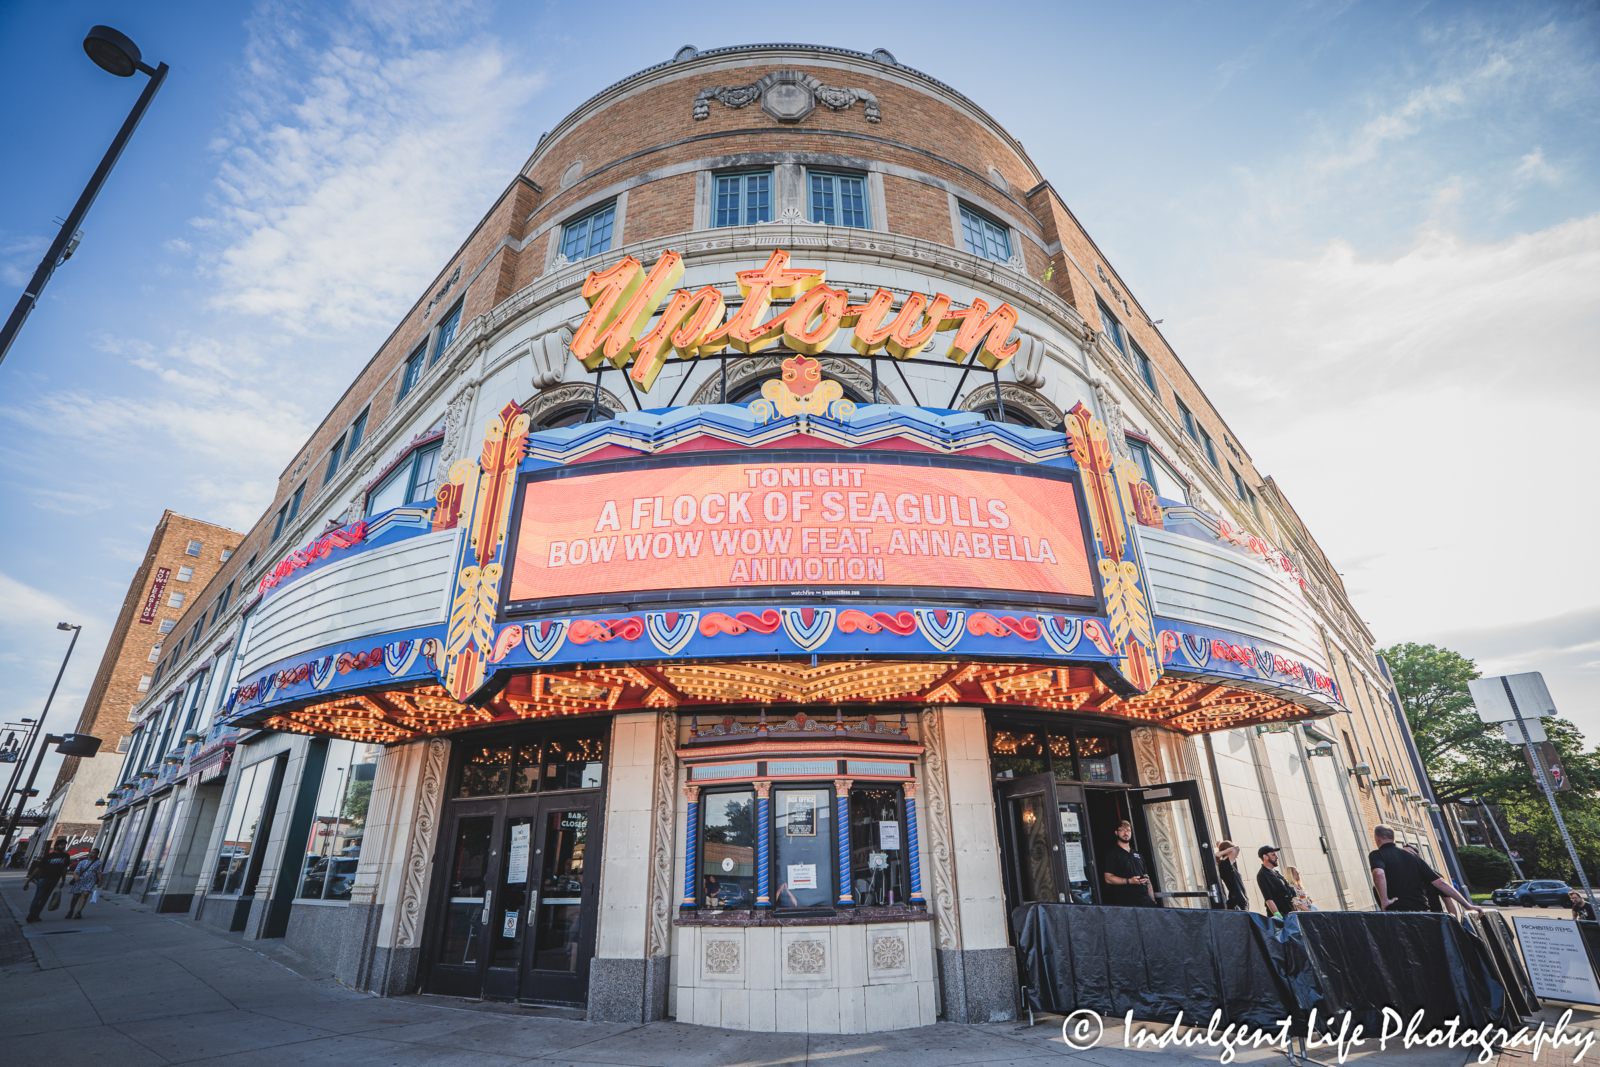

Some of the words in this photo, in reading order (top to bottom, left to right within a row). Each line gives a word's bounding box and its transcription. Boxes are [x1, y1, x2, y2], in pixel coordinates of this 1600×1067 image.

[569, 248, 1021, 393] Uptown
[744, 468, 865, 488] TONIGHT
[594, 500, 621, 533] A
[631, 491, 753, 529] FLOCK
[763, 491, 813, 523] OF
[821, 491, 1010, 529] SEAGULLS
[547, 536, 618, 568] BOW
[624, 530, 704, 561] WOW
[711, 527, 793, 556] WOW
[801, 527, 881, 554] FEAT.
[888, 528, 1058, 564] ANNABELLA
[155, 569, 165, 583] NOW
[730, 557, 885, 582] ANIMOTION
[142, 584, 158, 617] LEASING
[1521, 924, 1554, 932] PROHIBITED
